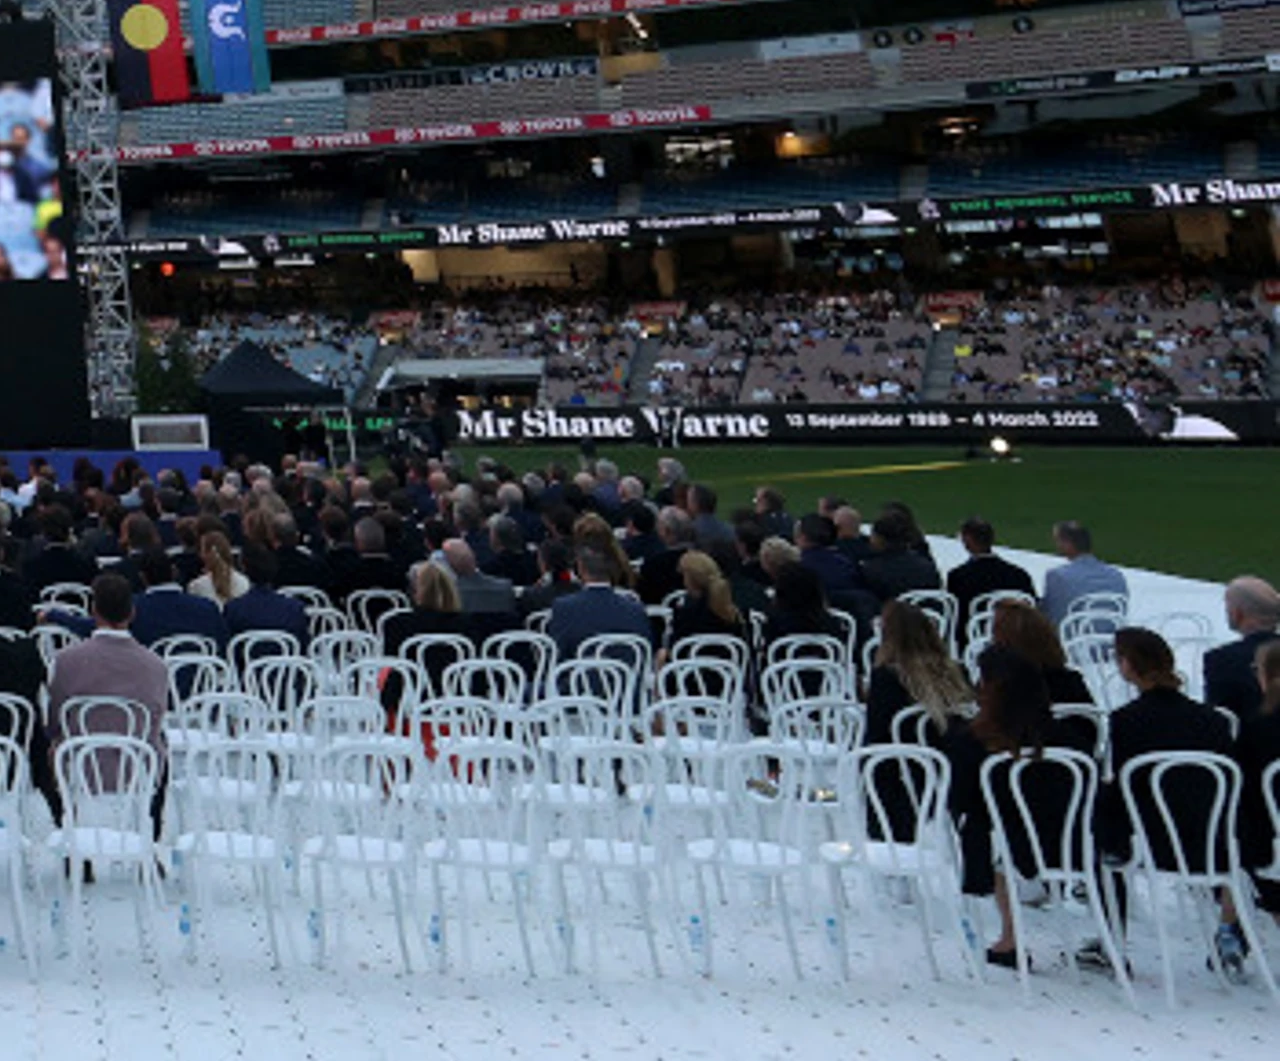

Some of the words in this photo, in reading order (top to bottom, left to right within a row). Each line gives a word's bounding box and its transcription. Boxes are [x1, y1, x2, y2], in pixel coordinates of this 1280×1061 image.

[1151, 183, 1200, 206] Mr
[437, 224, 473, 243] Mr
[476, 222, 546, 242] Shane
[549, 219, 630, 239] Warne
[457, 409, 515, 438] Mr
[522, 408, 634, 438] Shane
[640, 407, 770, 438] Warne
[807, 412, 903, 429] September
[988, 411, 1049, 426] March
[1052, 411, 1099, 426] 2022
